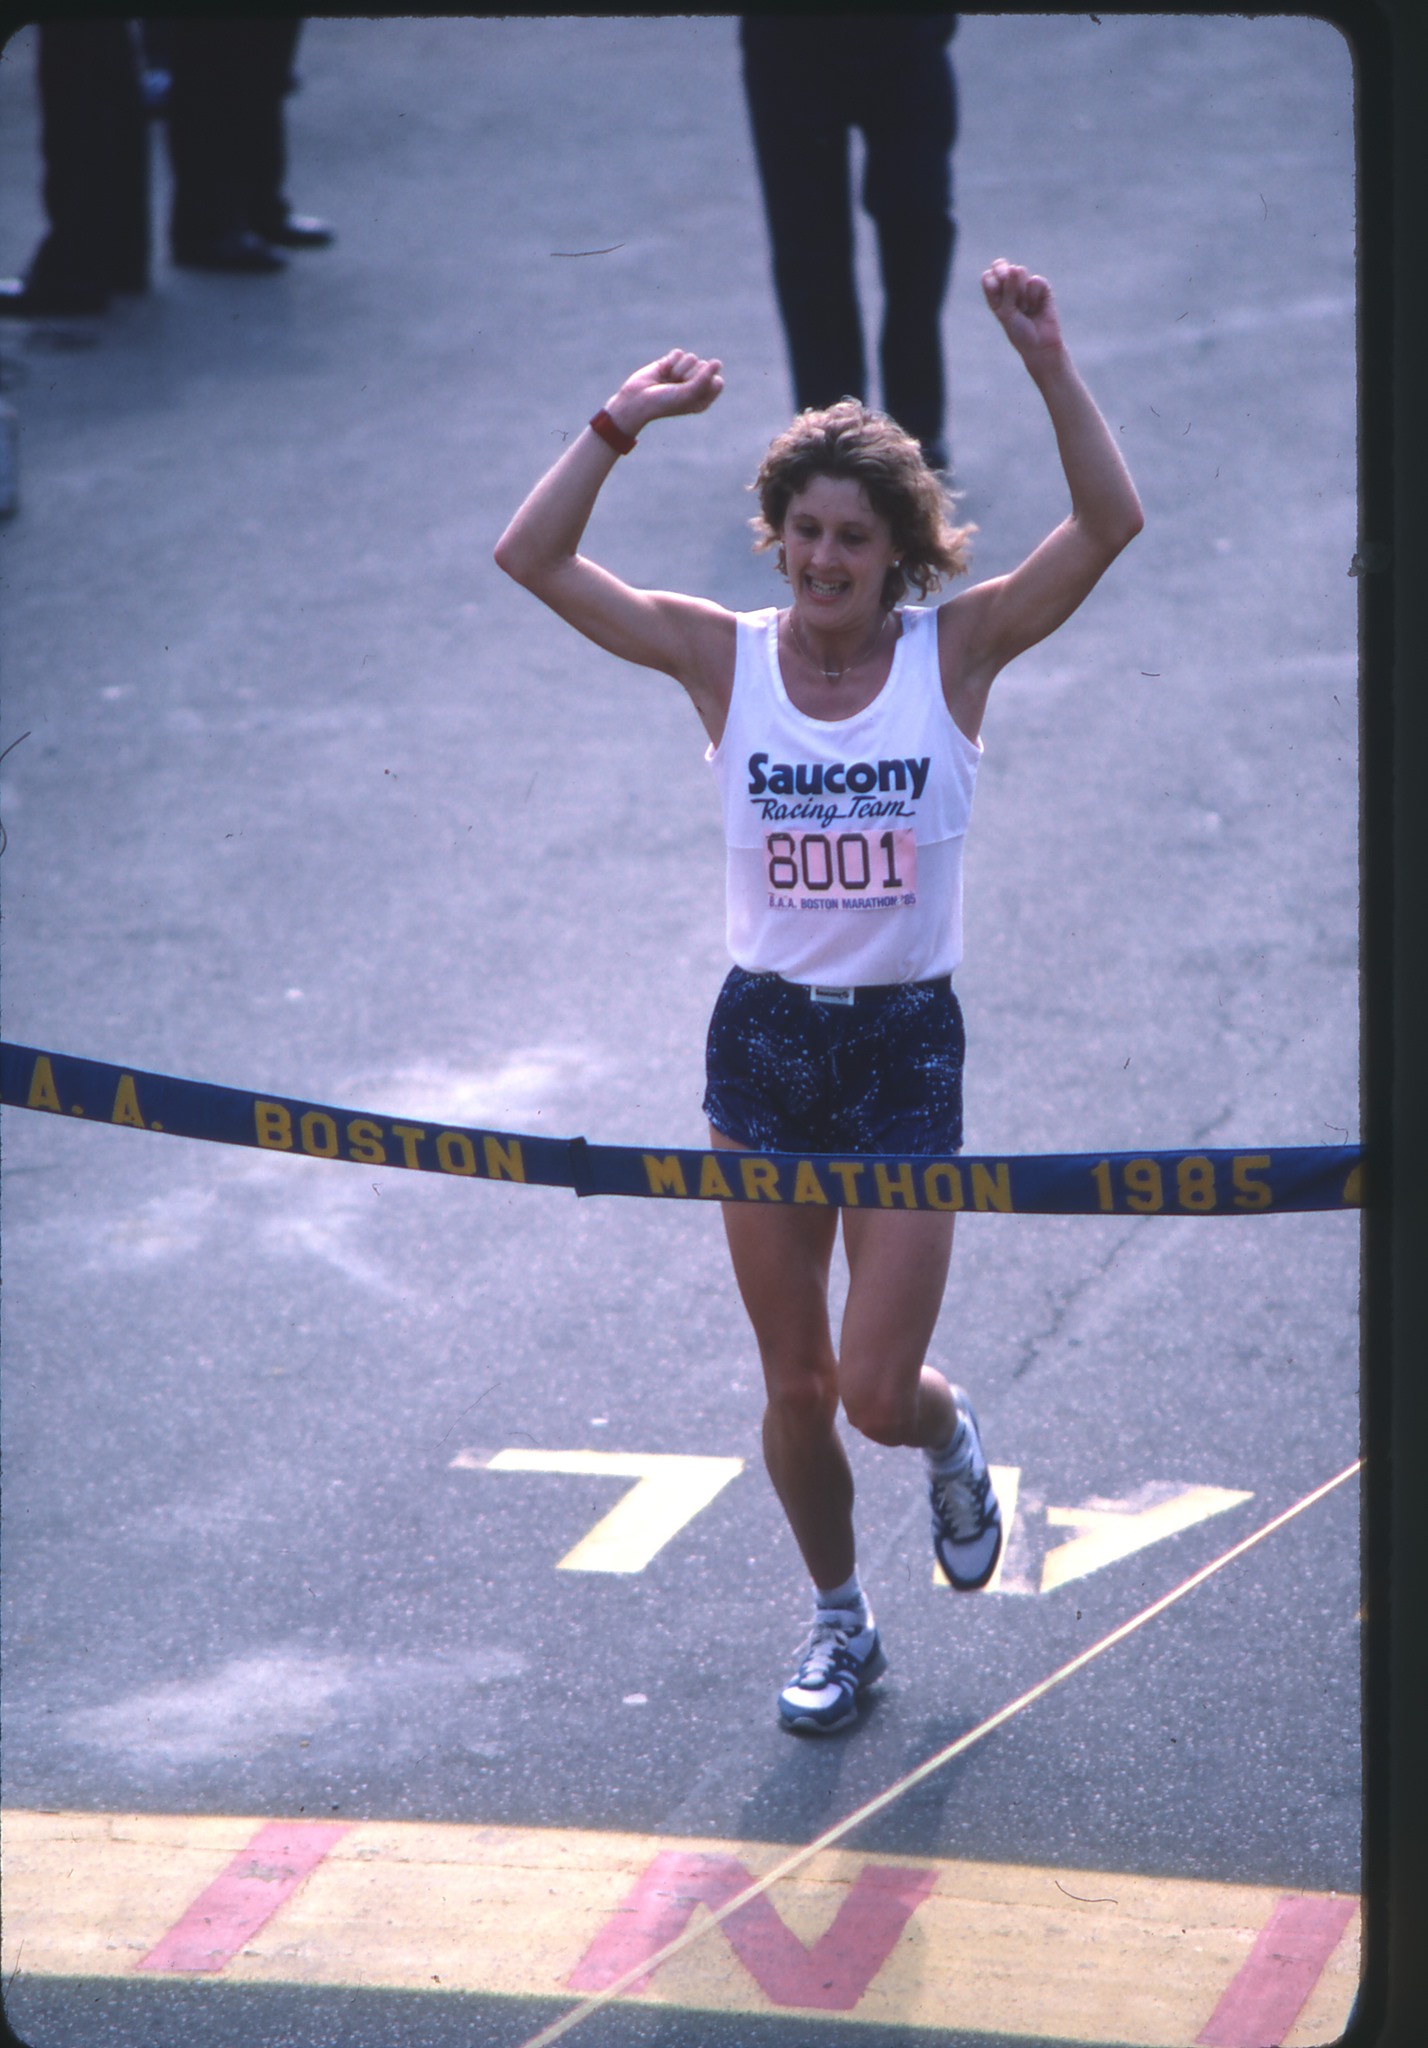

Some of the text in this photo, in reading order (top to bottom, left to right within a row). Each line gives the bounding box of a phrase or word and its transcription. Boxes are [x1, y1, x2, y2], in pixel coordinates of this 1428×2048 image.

[748, 752, 931, 800] Saucony
[751, 796, 916, 828] Racing Team
[766, 832, 903, 890] 8001
[800, 898, 839, 909] BOSTON
[842, 896, 897, 909] MARATHON
[253, 1101, 526, 1183] BOSTON
[642, 1154, 1013, 1213] MARATHON
[1092, 1155, 1272, 1211] 1985
